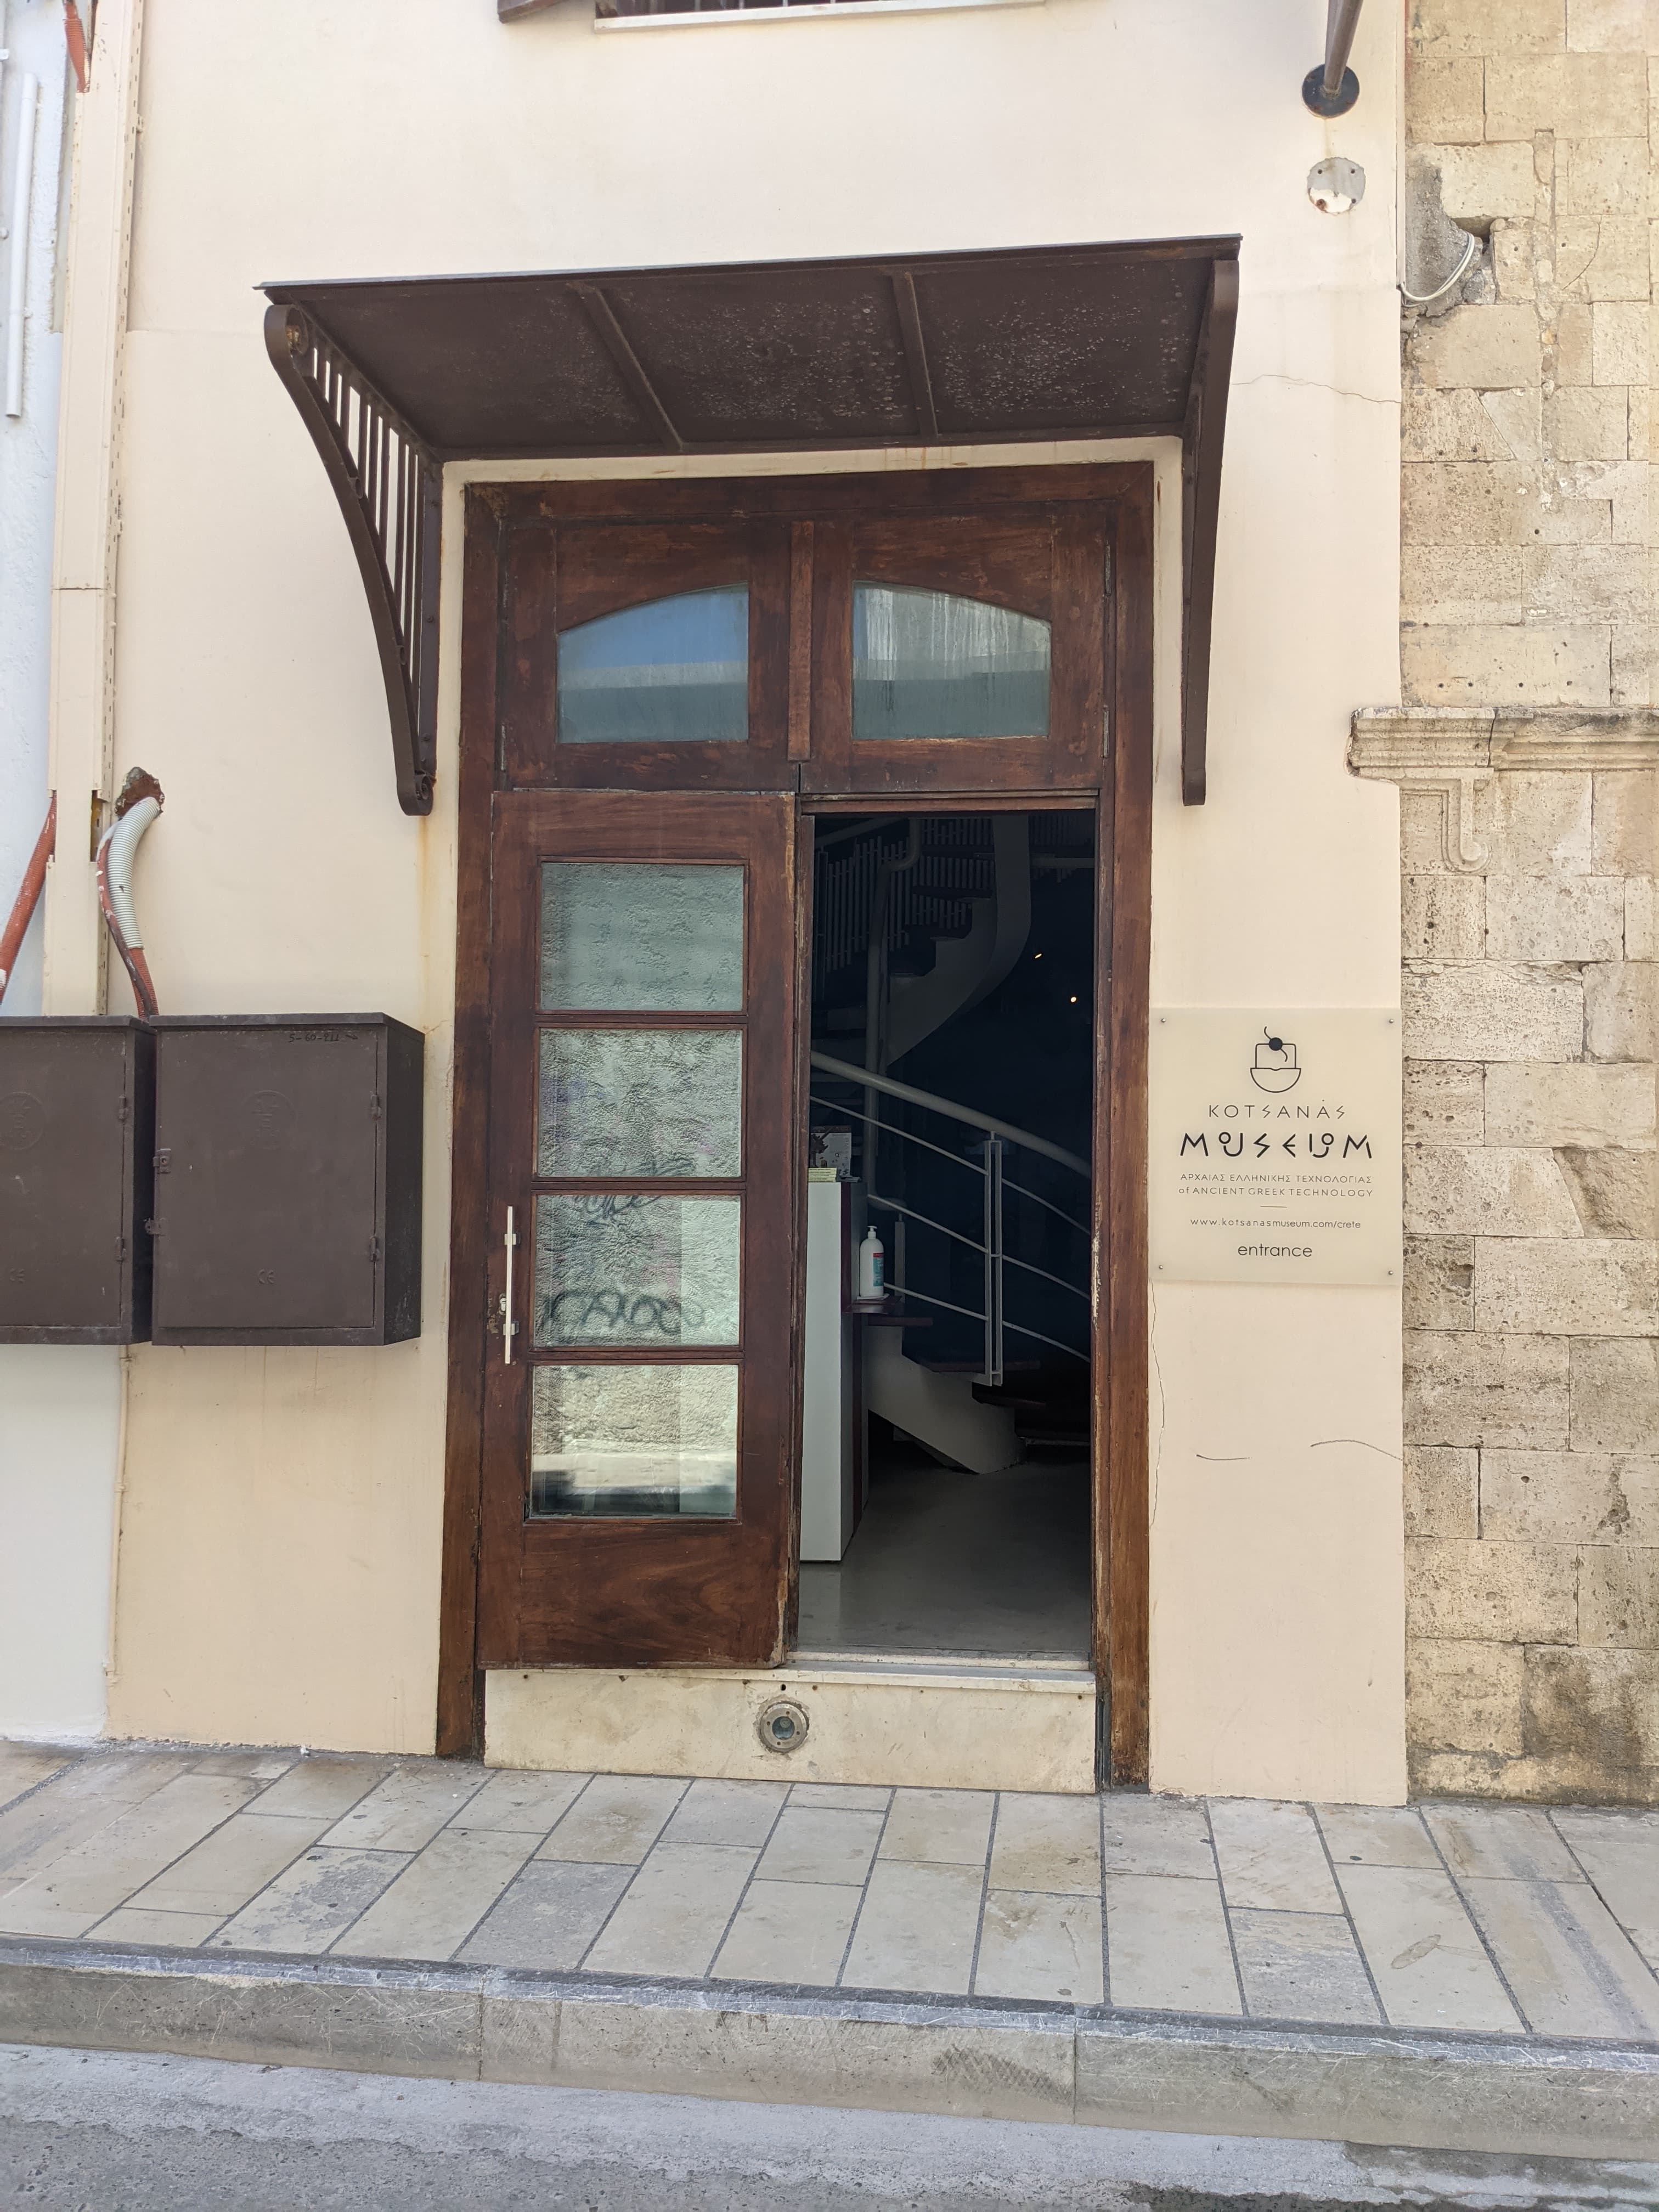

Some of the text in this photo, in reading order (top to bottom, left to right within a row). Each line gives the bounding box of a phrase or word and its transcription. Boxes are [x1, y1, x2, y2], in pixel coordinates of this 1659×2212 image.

[1230, 1174, 1291, 1183] ΕΛΛΗΝΙΚΗΣ
[1295, 1175, 1372, 1183] ΤΕΧΝΟΛΟΓΙΑΣ
[1248, 1188, 1285, 1196] GREEK
[1289, 1188, 1373, 1198] TECHNOLOGY
[1190, 1217, 1361, 1229] www.kotsanasmuseum.com/crete
[1238, 1243, 1313, 1257] entrance
